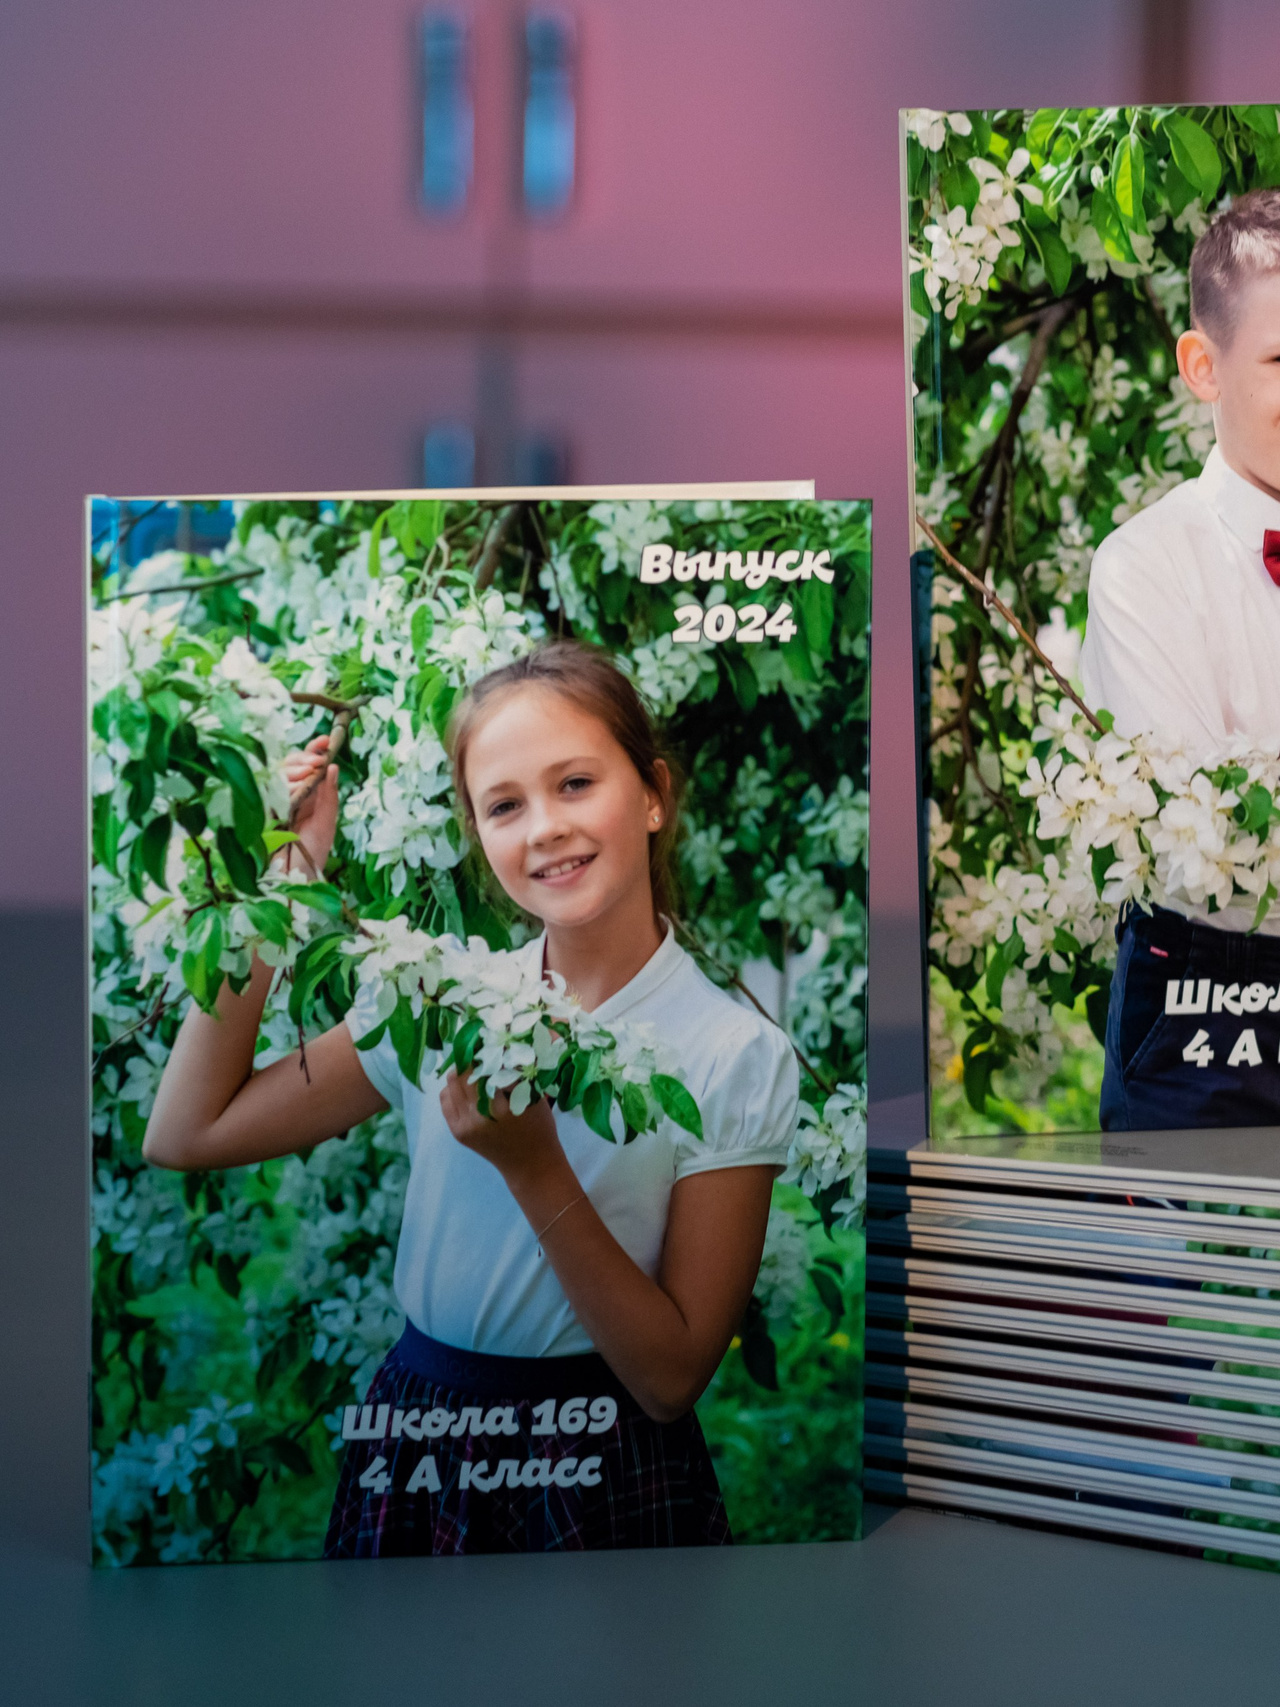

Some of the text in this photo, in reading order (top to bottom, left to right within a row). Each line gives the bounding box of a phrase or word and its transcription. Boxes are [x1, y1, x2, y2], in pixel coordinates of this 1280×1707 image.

[640, 544, 835, 590] Выпуск
[672, 602, 797, 643] 2024
[1182, 1029, 1214, 1067] 4
[342, 1396, 618, 1441] Школа 169
[358, 1455, 391, 1494] 4
[458, 1456, 603, 1493] класс
